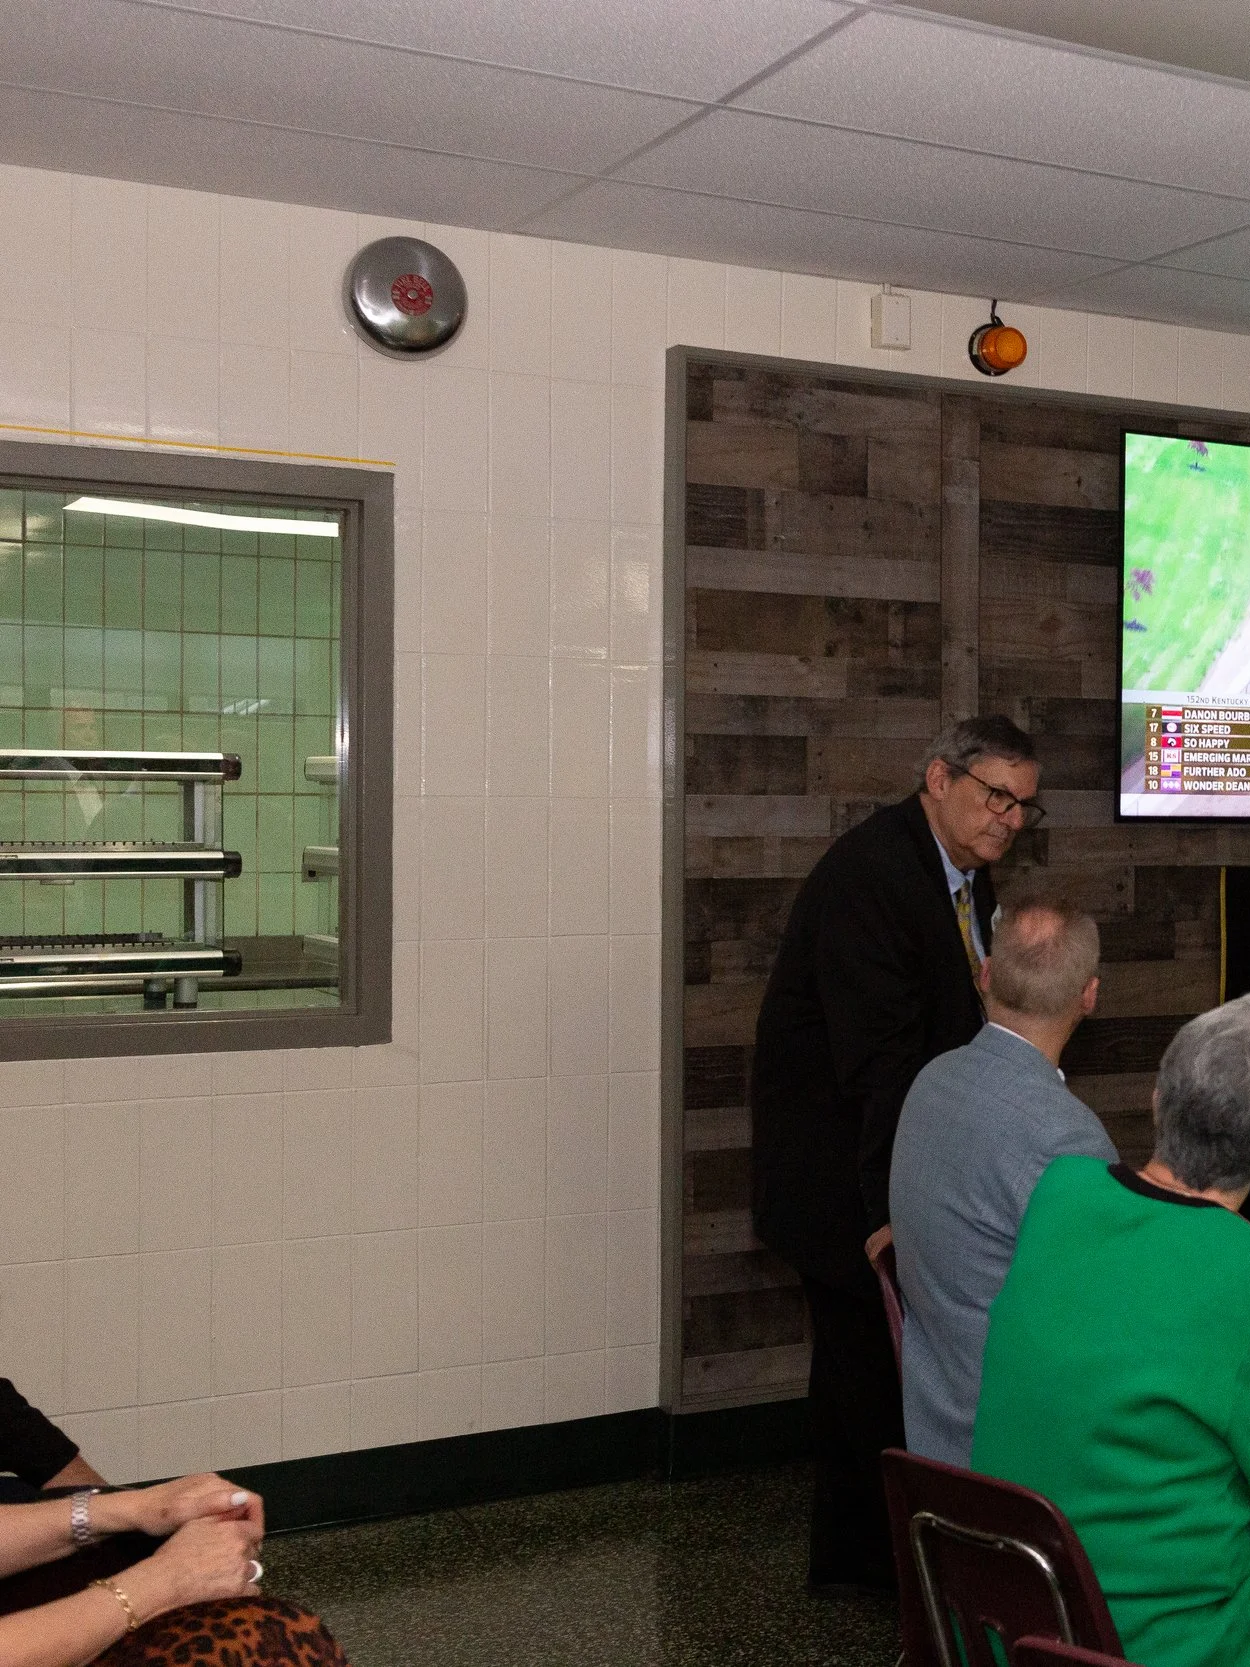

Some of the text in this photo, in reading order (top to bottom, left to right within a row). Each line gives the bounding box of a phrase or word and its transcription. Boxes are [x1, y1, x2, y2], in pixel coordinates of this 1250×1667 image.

[1151, 708, 1157, 718] 7
[1184, 709, 1217, 720] DANON
[1149, 722, 1159, 733] 17
[1184, 723, 1200, 734] SIX
[1201, 724, 1231, 735] SPEED
[1150, 737, 1157, 747] 8
[1184, 737, 1197, 748] SO
[1199, 738, 1230, 749] HAPPY
[1148, 751, 1158, 761] 15
[1184, 752, 1230, 763] EMERGING
[1148, 766, 1159, 776] 18
[1184, 766, 1225, 777] FURTHER
[1226, 767, 1246, 777] ADO
[1148, 780, 1159, 790] 10
[1184, 781, 1224, 791] WONDER
[1226, 782, 1250, 792] DEAN
